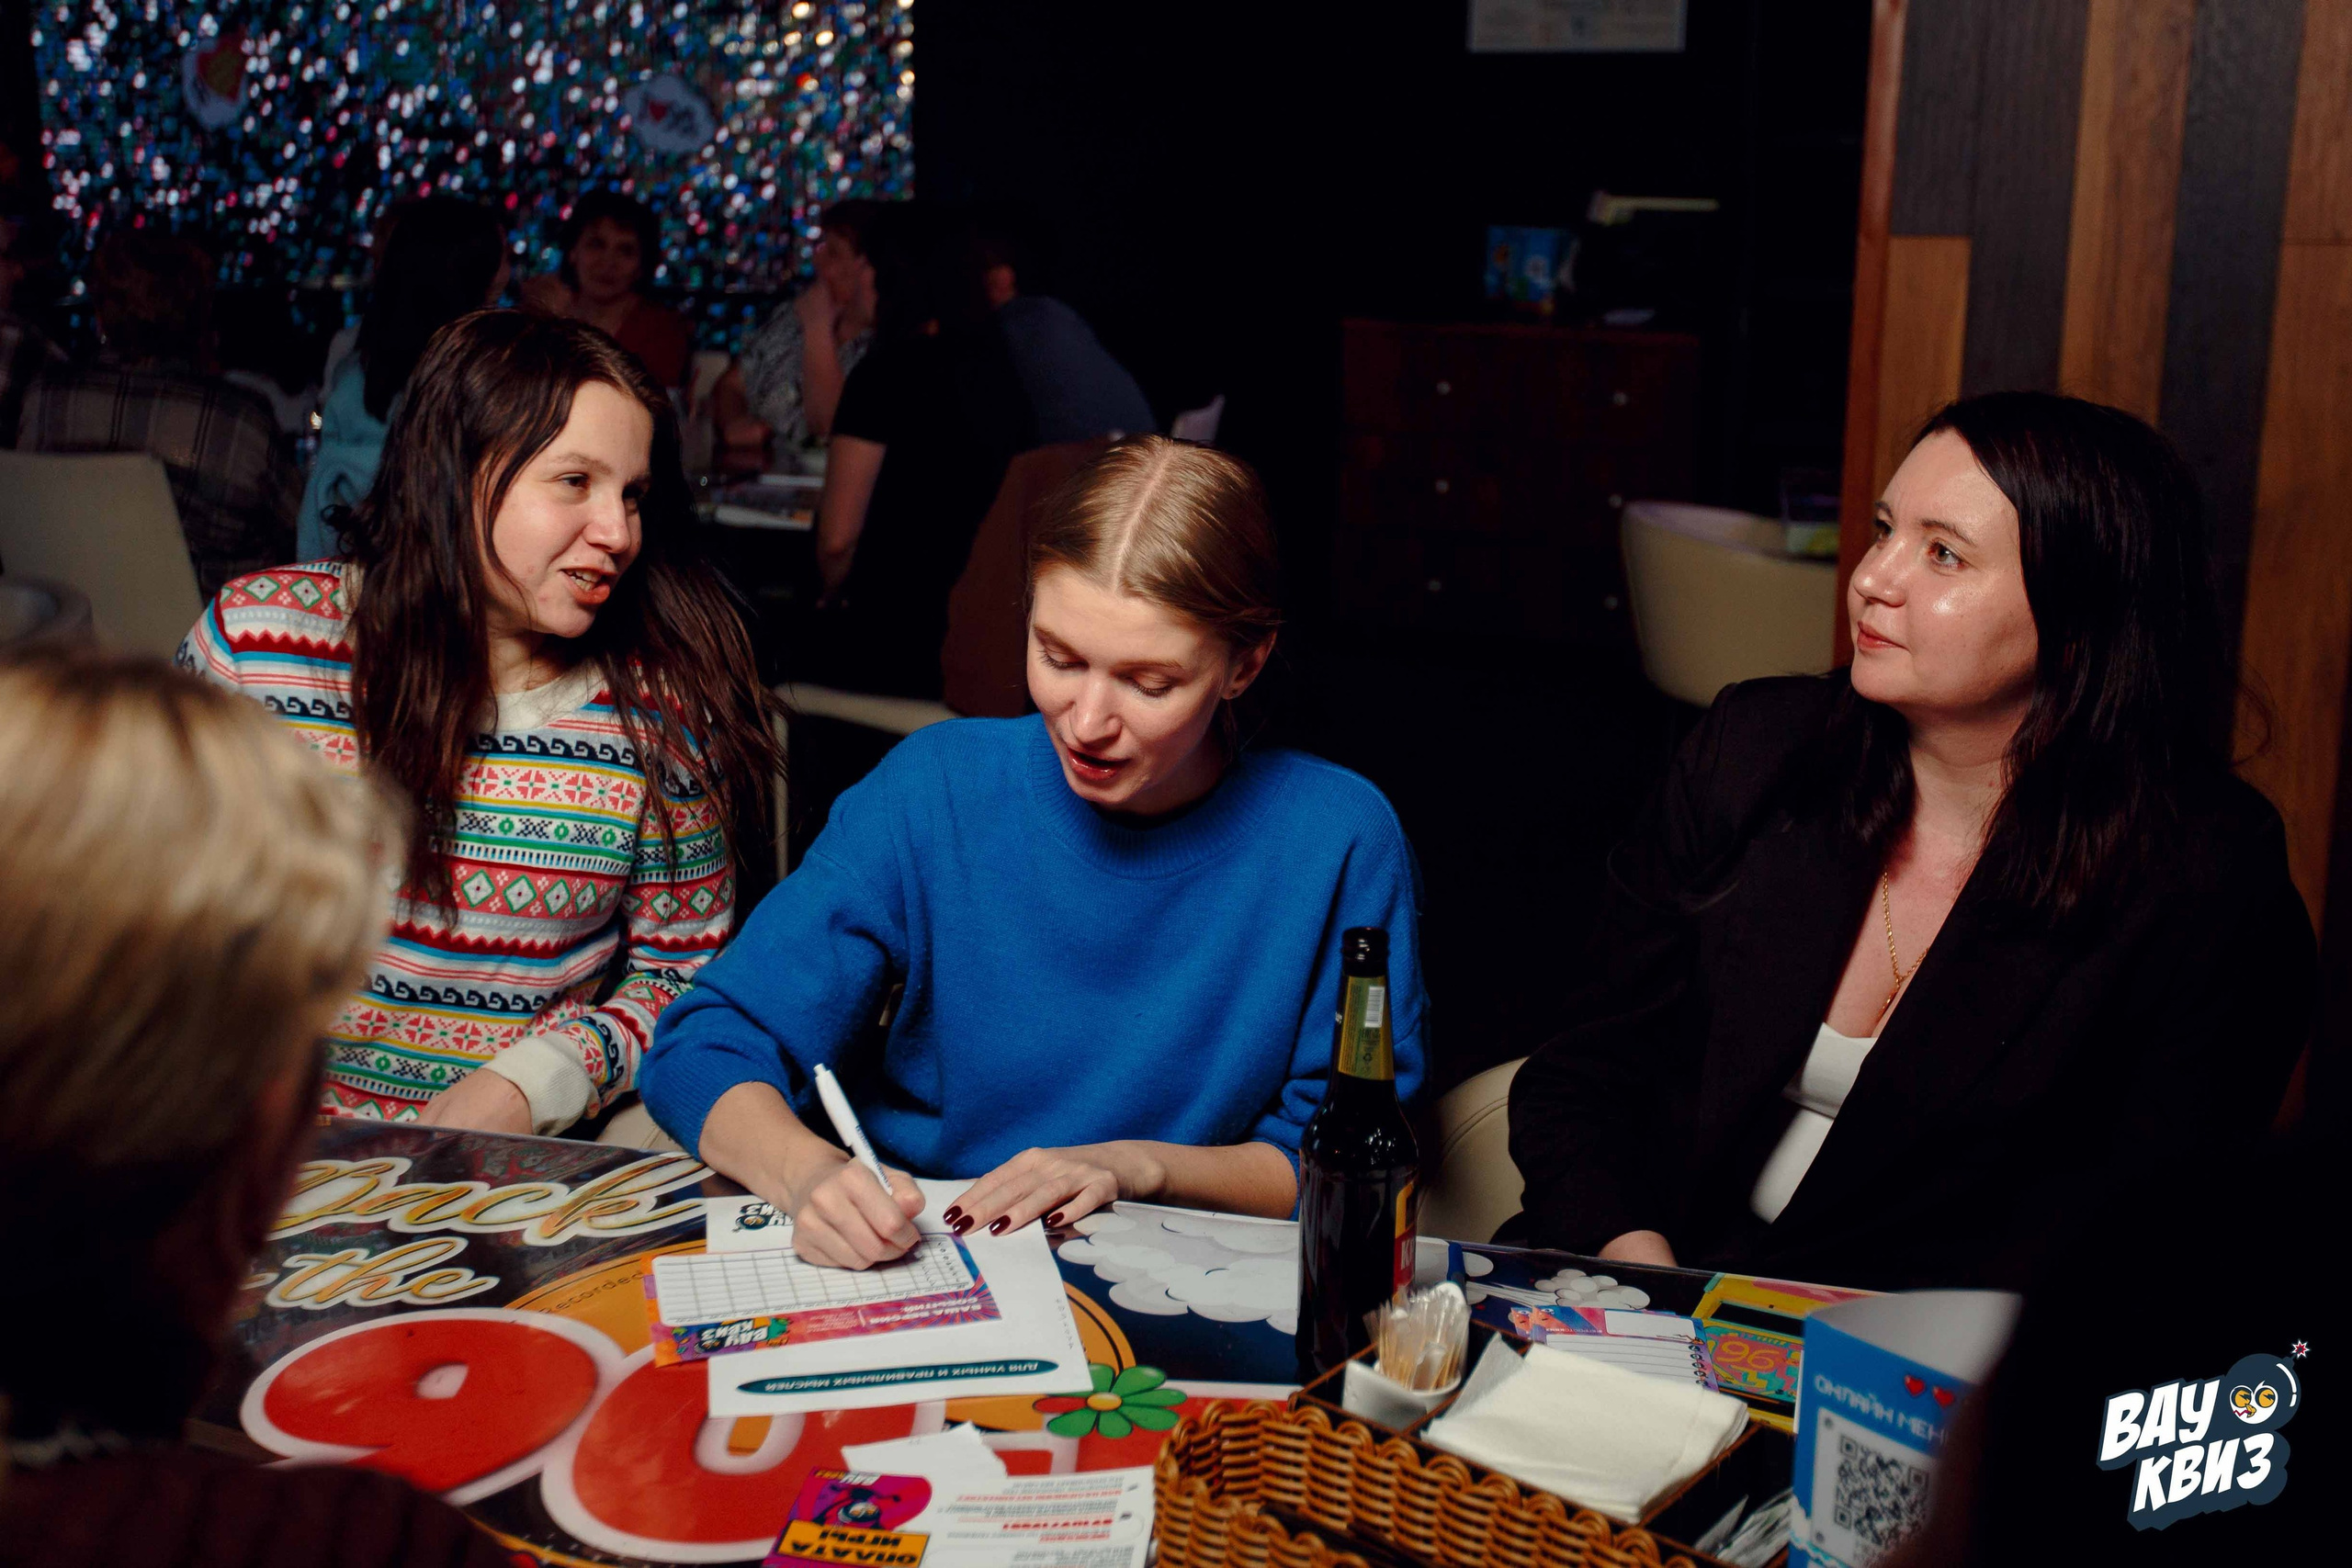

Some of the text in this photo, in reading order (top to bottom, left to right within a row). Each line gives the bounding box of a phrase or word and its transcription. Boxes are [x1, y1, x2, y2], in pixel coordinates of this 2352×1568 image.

[266, 1236, 499, 1310] the
[701, 1319, 753, 1341] КВИЗ
[723, 1325, 769, 1348] ВАУ
[764, 1362, 1039, 1392] ДЛЯ УМНЫХ И ПРАВИЛЬНЫХ МЫСЛЕЙ
[1815, 1374, 1950, 1446] ОНЛАЙН МЕН
[820, 1529, 902, 1547] ИГРЫ
[792, 1540, 918, 1563] ОПЛАТА
